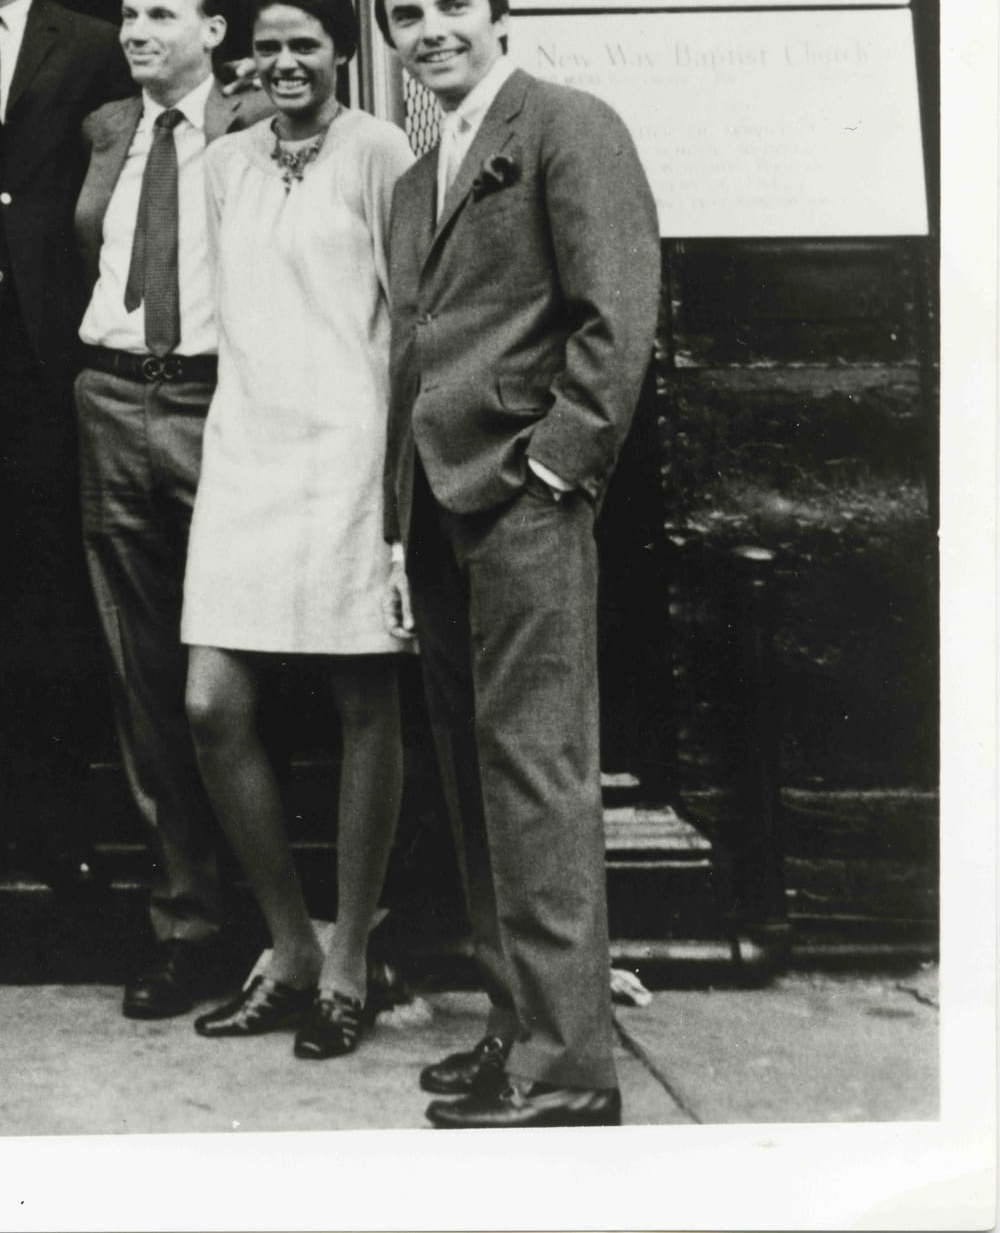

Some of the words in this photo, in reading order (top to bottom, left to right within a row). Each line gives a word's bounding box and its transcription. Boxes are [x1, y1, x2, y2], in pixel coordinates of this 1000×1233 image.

[536, 43, 591, 70] New
[604, 42, 657, 70] Way
[674, 41, 769, 72] Baptist
[784, 39, 872, 68] Church
